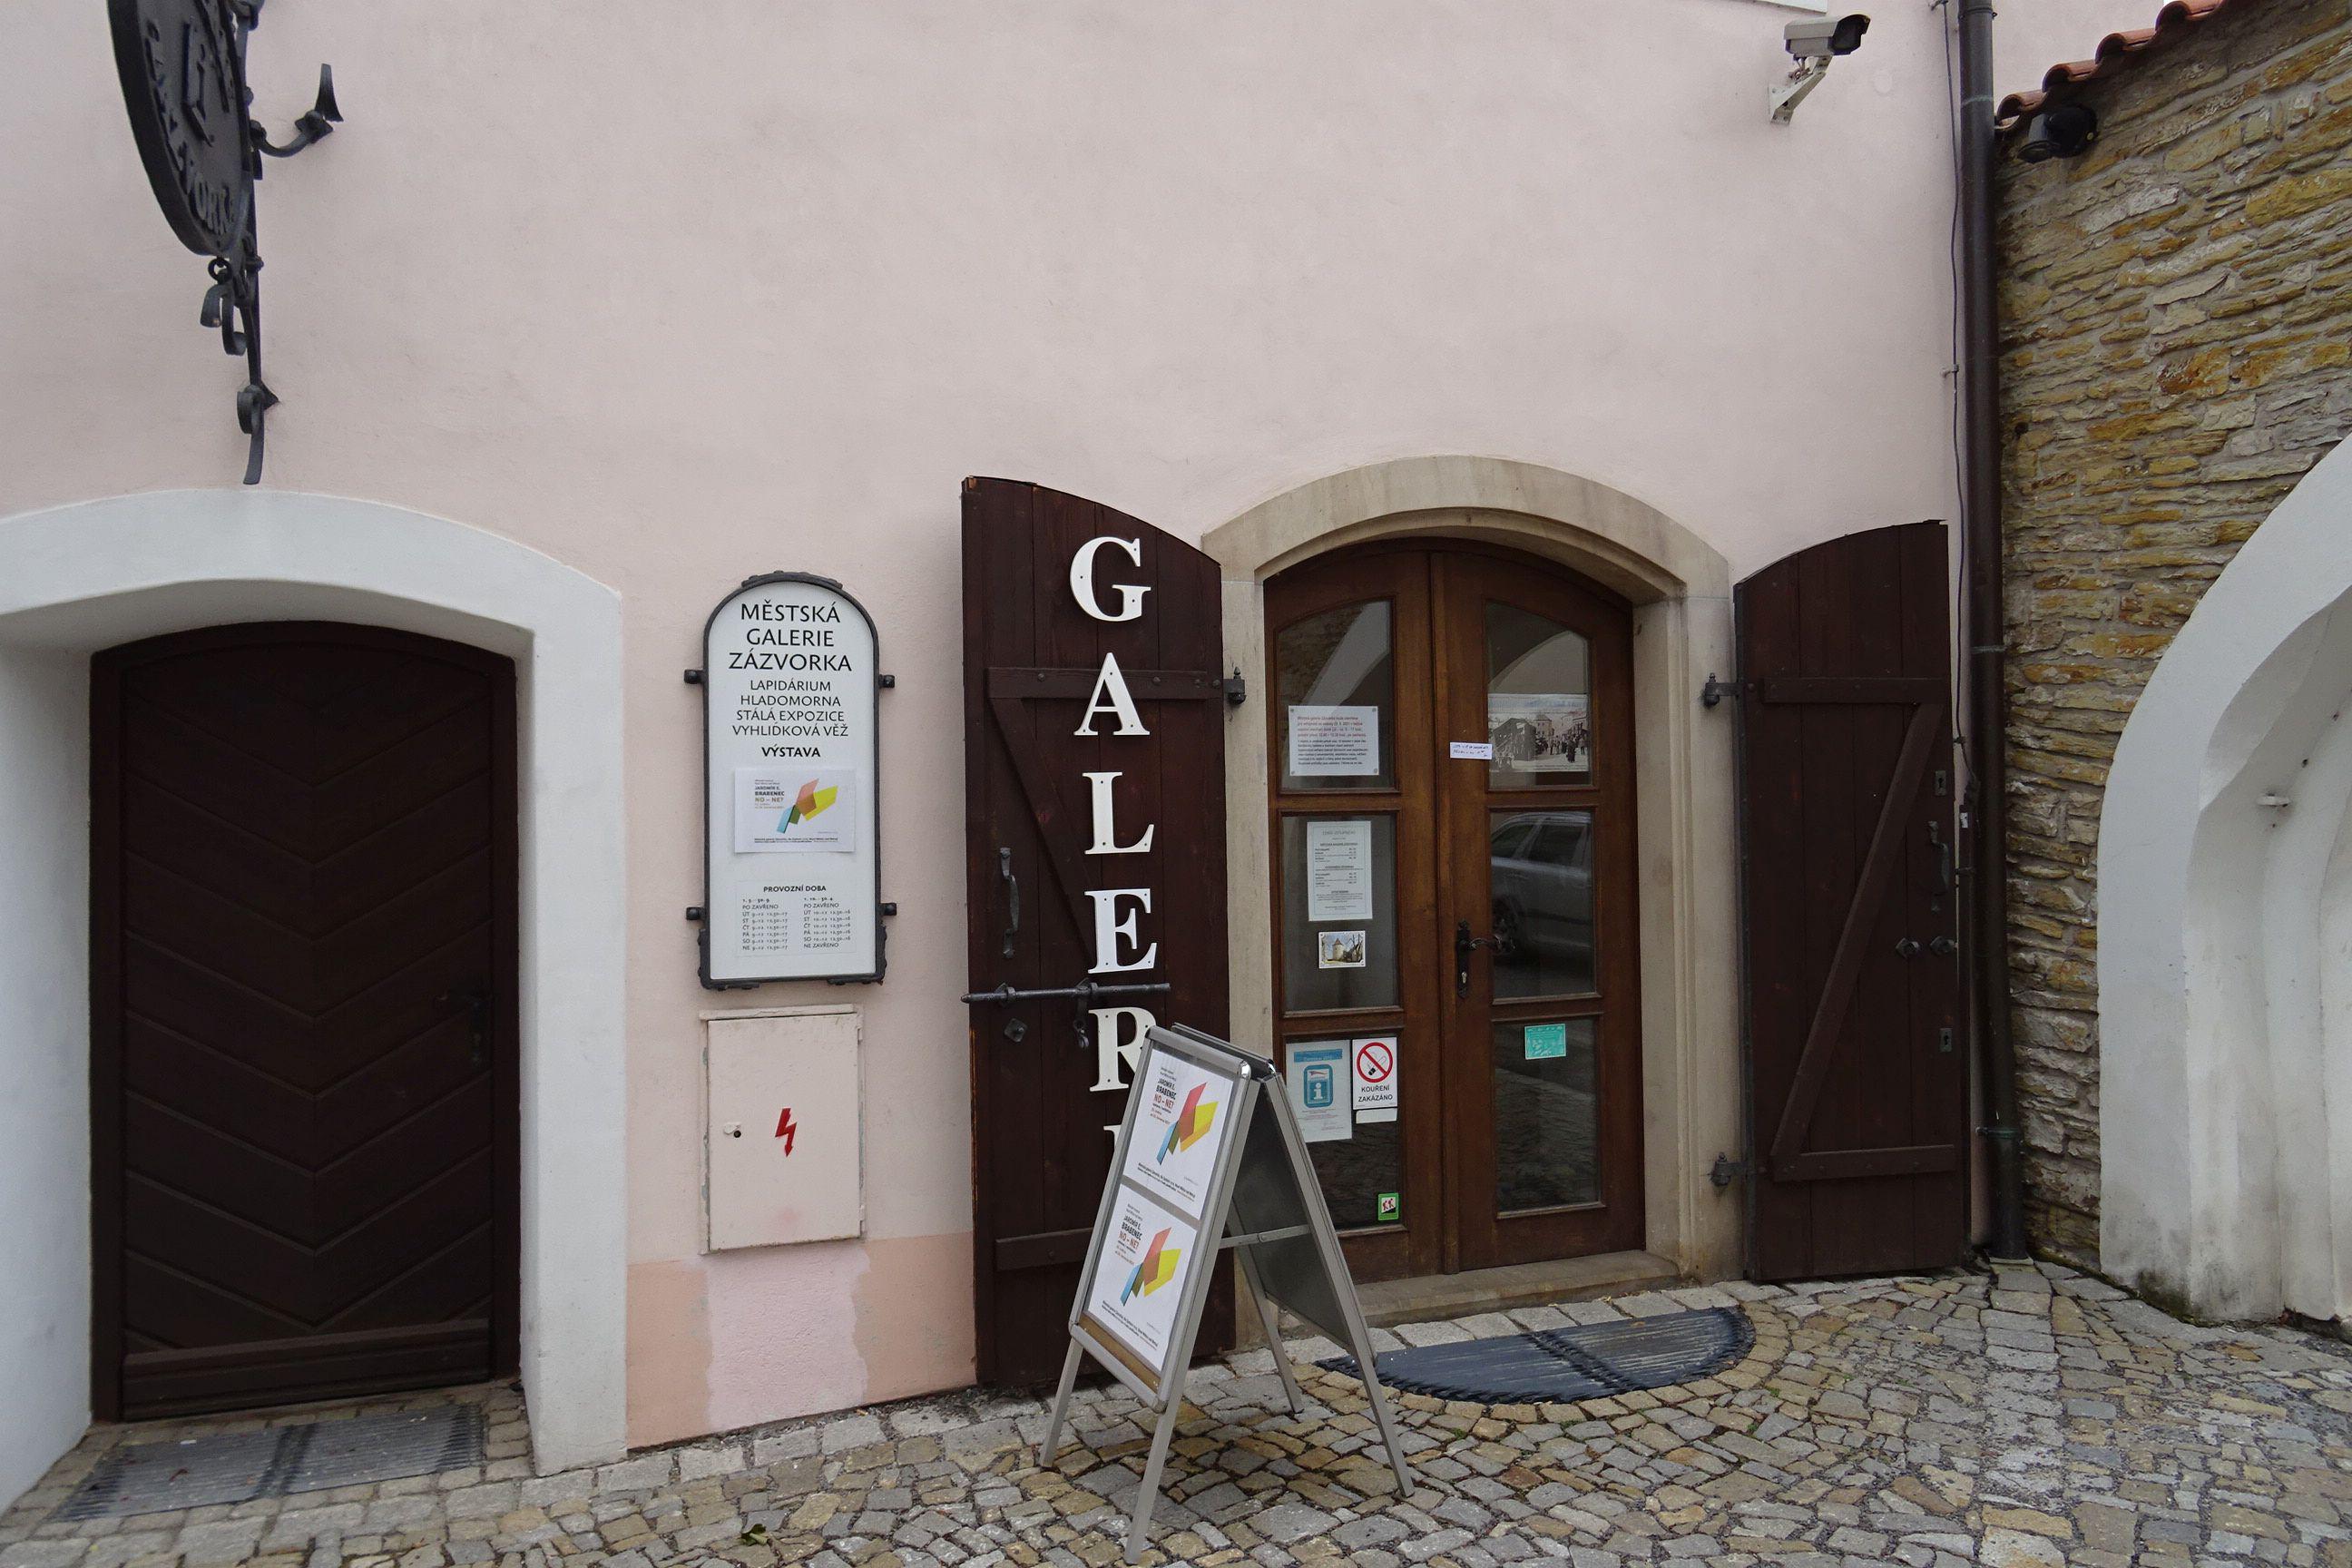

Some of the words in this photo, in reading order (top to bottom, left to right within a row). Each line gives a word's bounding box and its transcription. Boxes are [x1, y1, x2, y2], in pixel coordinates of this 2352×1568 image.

[740, 599, 840, 622] MĚSTSKÁ
[746, 629, 834, 647] GALERIE
[729, 648, 852, 671] ZÁZVORKA
[750, 678, 831, 691] LAPIDÁRIUM
[740, 695, 841, 707] HLADOMORNA
[736, 708, 775, 721] STÁLÁ
[779, 710, 845, 722] EXPOZICE
[731, 721, 820, 737] VYHLÍDKOVÁ
[823, 723, 849, 737] VĚŽ
[761, 744, 821, 758] VÝSTAVA
[763, 884, 804, 893] PROVOZNÍ
[1361, 1083, 1390, 1093] KOUŘENÍ
[1357, 1093, 1393, 1102] ZAKÁZÁNO
